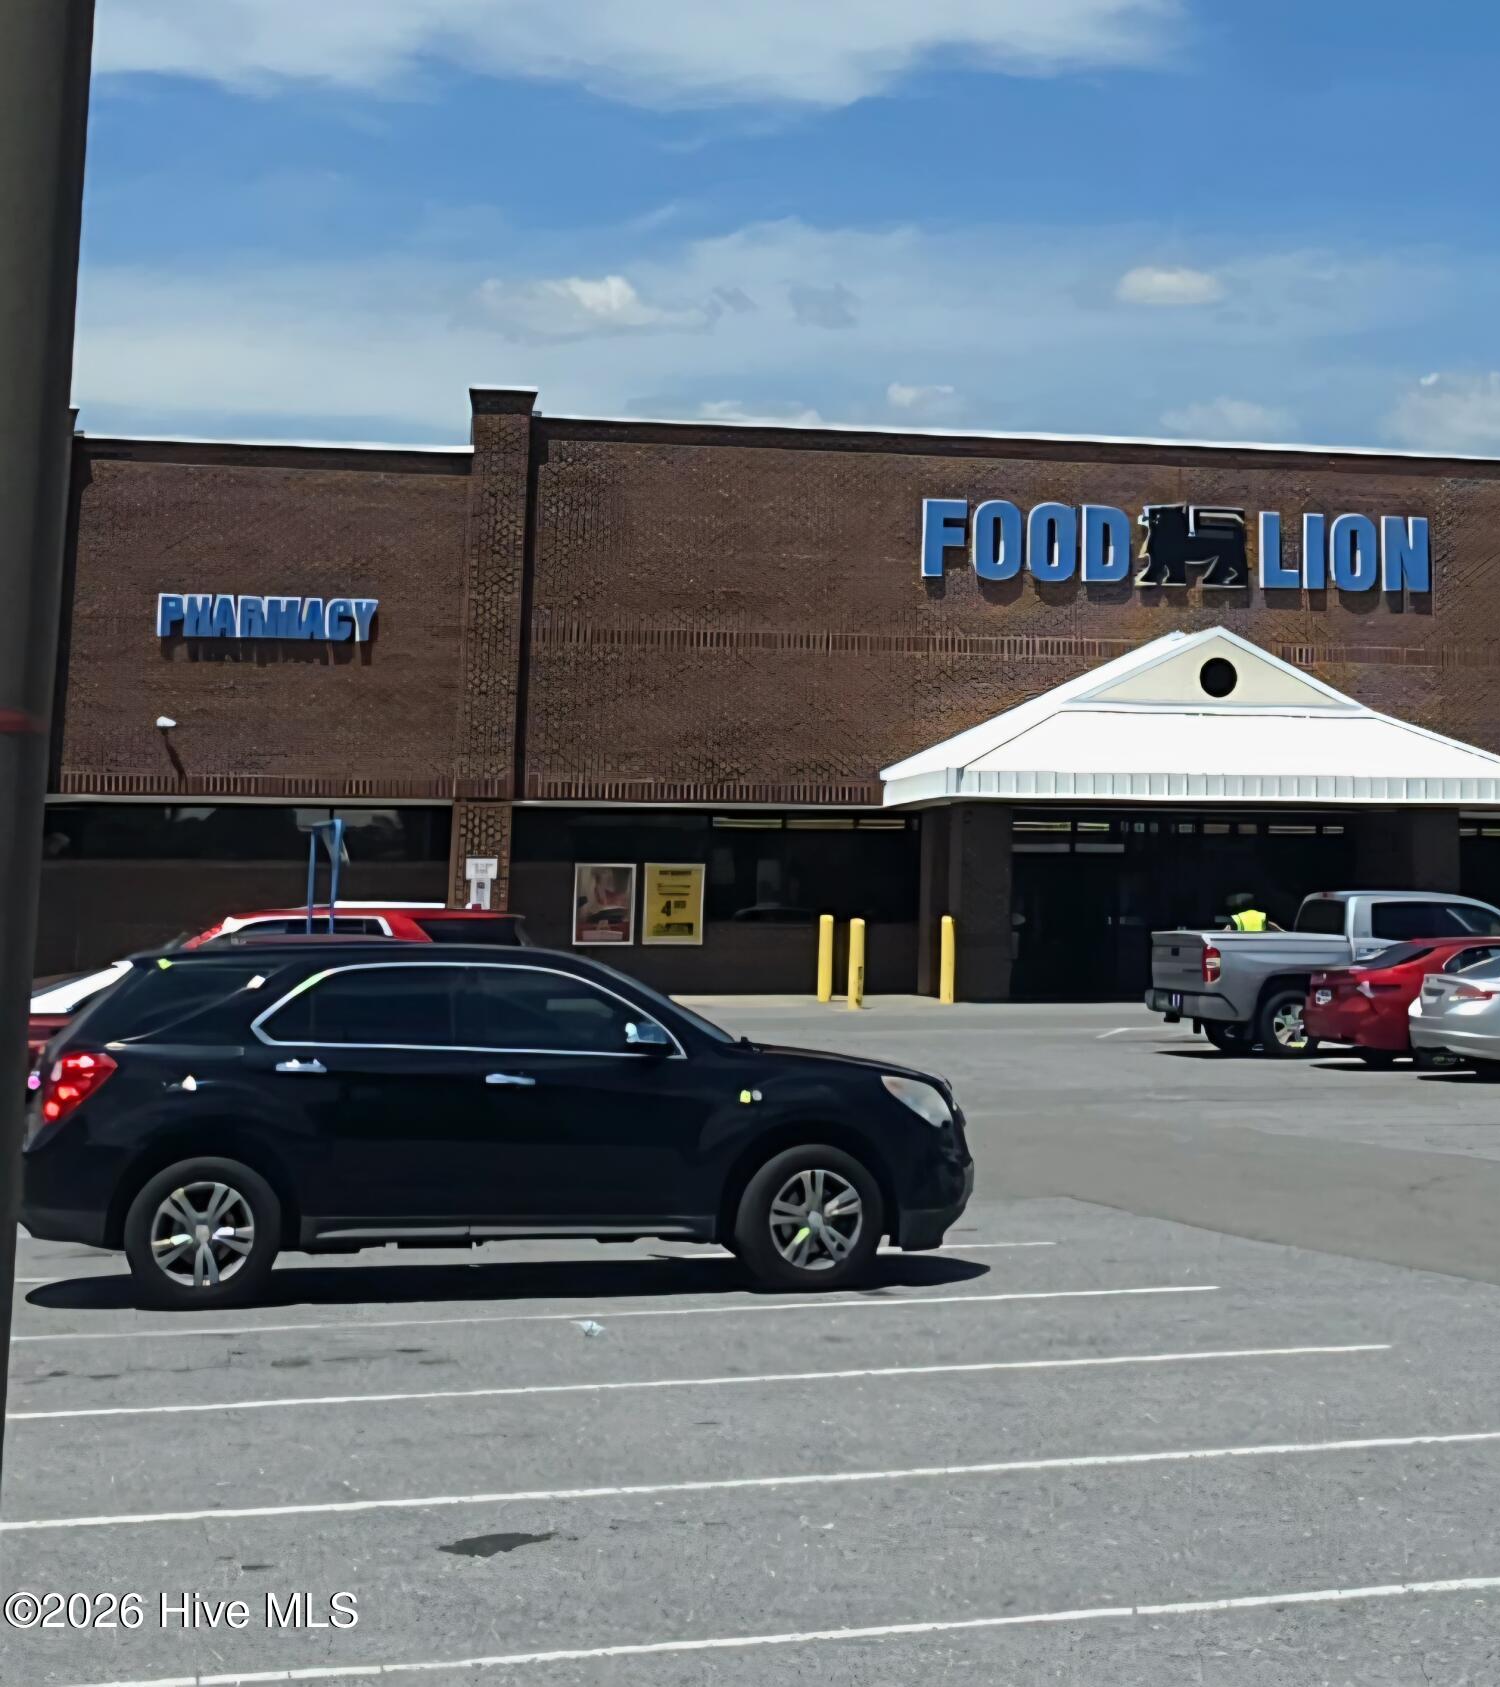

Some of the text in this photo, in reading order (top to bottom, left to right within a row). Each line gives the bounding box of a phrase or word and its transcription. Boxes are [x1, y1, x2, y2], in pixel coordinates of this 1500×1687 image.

[921, 498, 1430, 593] FOOD LION
[157, 593, 379, 642] PHARMACY
